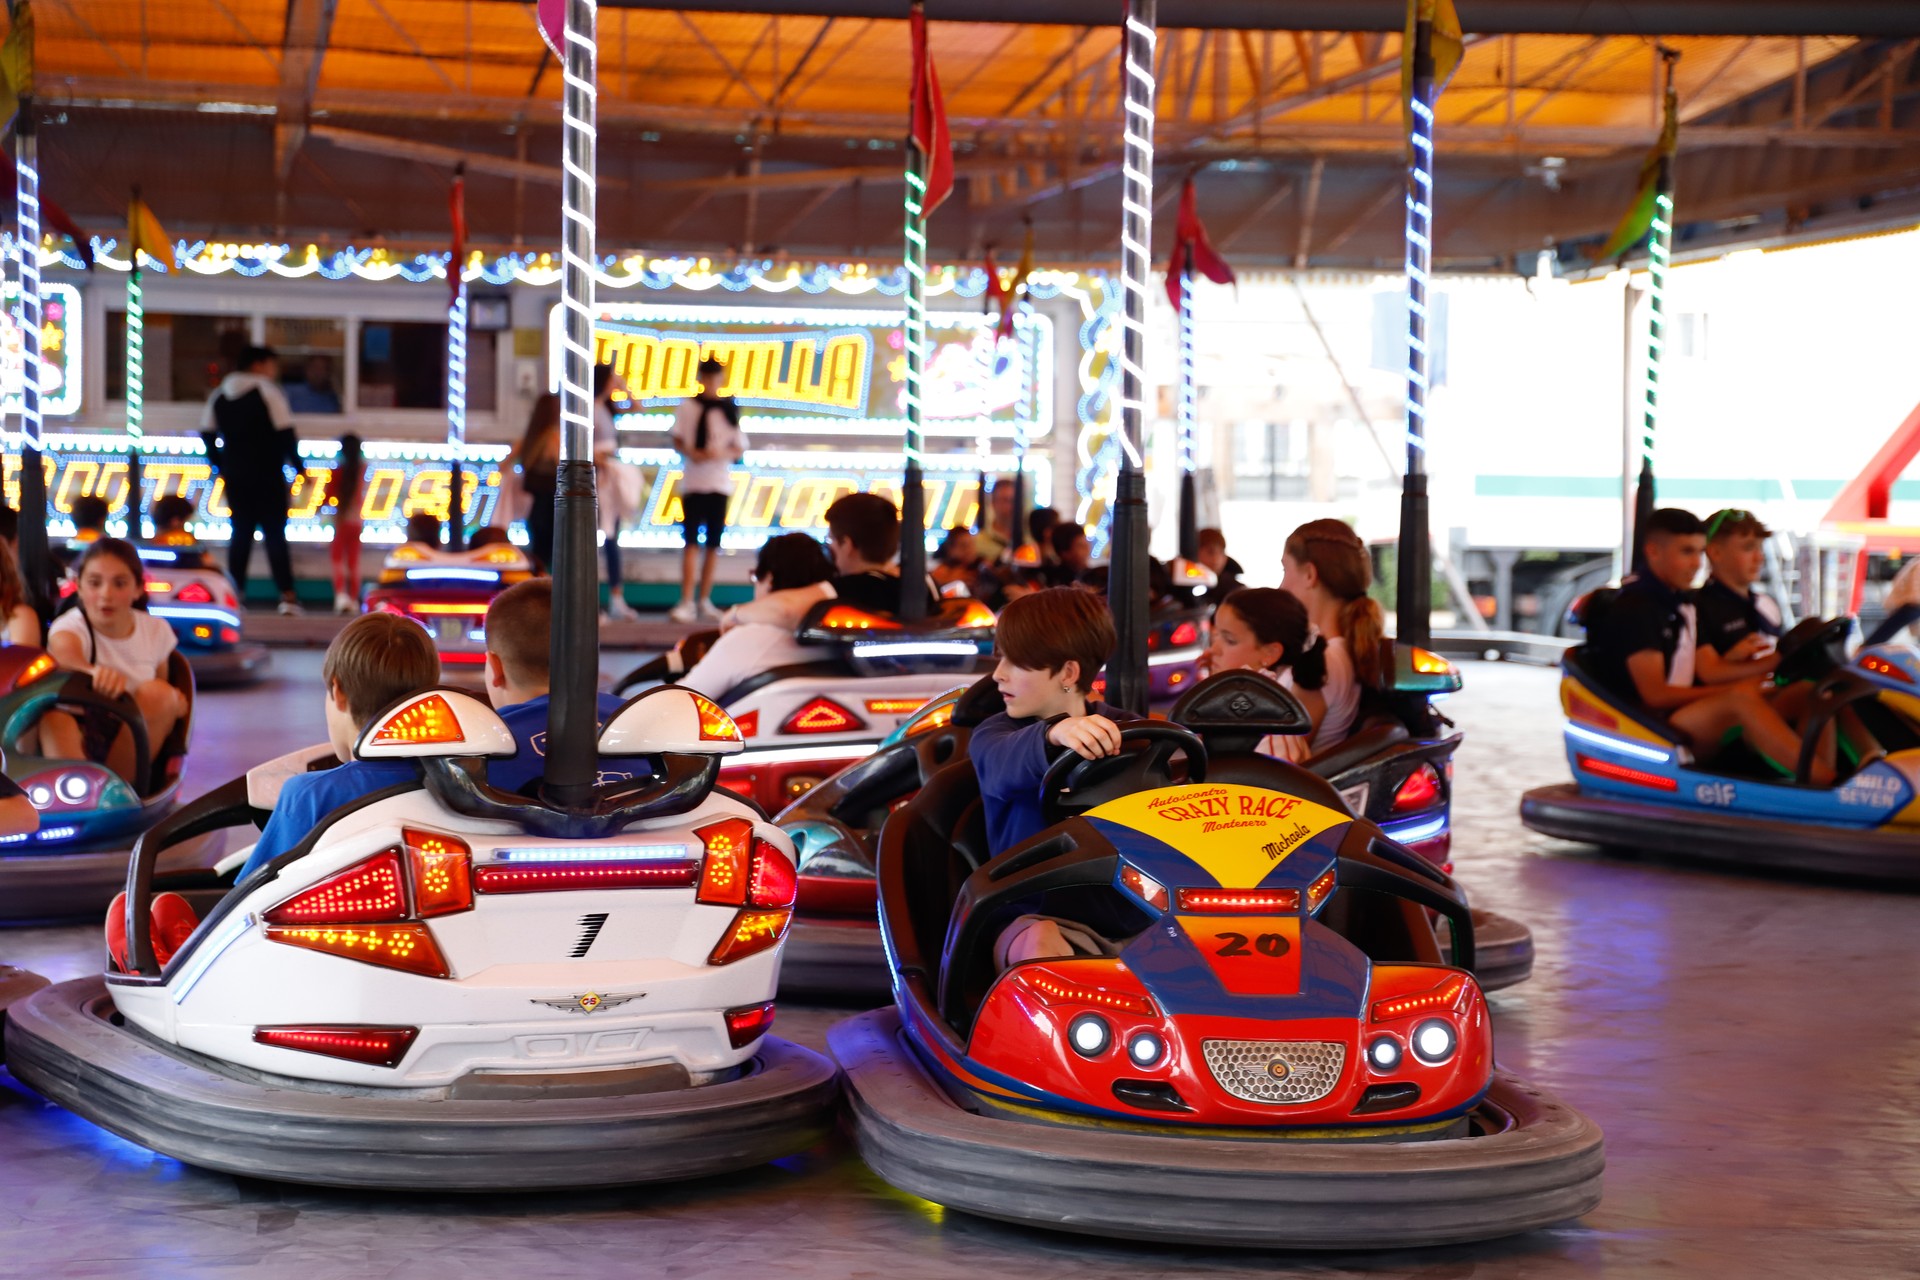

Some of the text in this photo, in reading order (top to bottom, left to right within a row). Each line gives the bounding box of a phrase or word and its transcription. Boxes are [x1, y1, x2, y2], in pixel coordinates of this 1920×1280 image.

[1147, 788, 1228, 810] Autoscontro
[1696, 781, 1736, 806] elf
[1839, 788, 1895, 808] SEVEN
[1158, 796, 1302, 821] CRAZY RACE
[1202, 819, 1267, 833] Montenero
[1261, 823, 1311, 860] Michaela
[1215, 932, 1290, 957] 20
